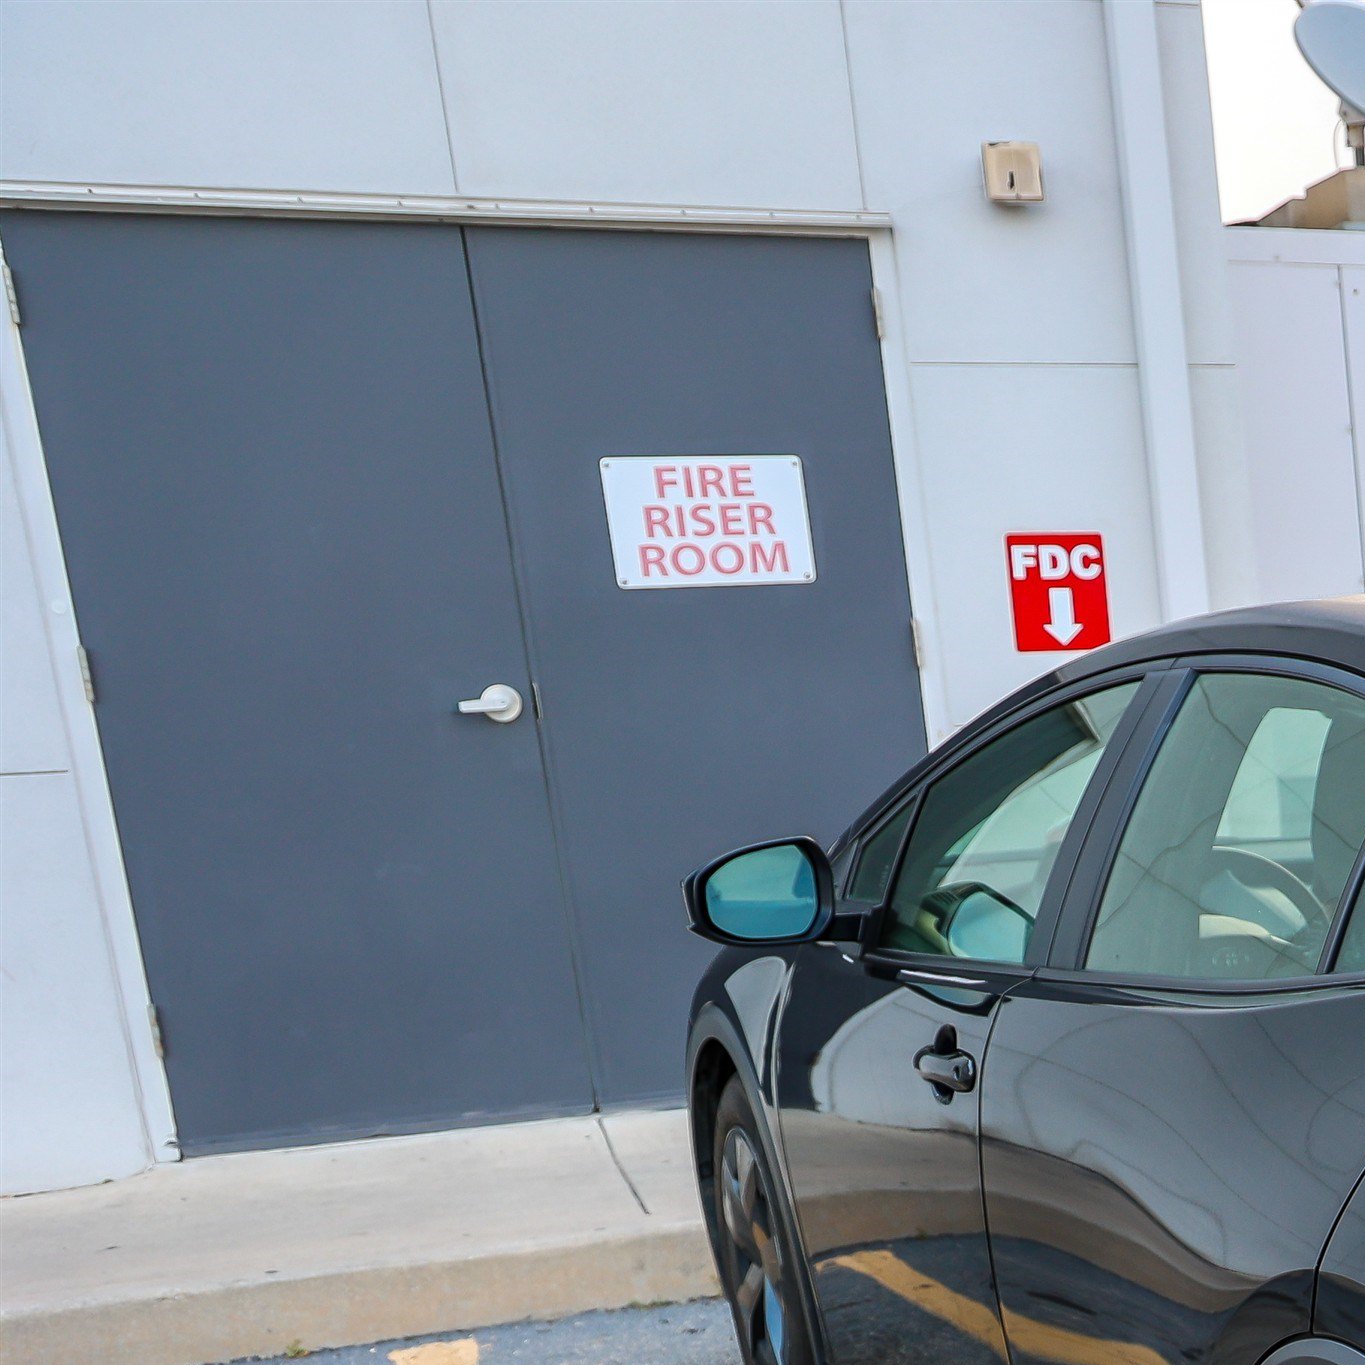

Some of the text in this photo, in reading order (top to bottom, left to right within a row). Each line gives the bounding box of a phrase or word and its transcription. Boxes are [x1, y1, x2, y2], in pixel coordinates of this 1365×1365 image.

[653, 464, 755, 498] FIRE
[642, 502, 776, 538] RISER
[638, 540, 790, 577] ROOM
[1010, 544, 1102, 580] FDC
